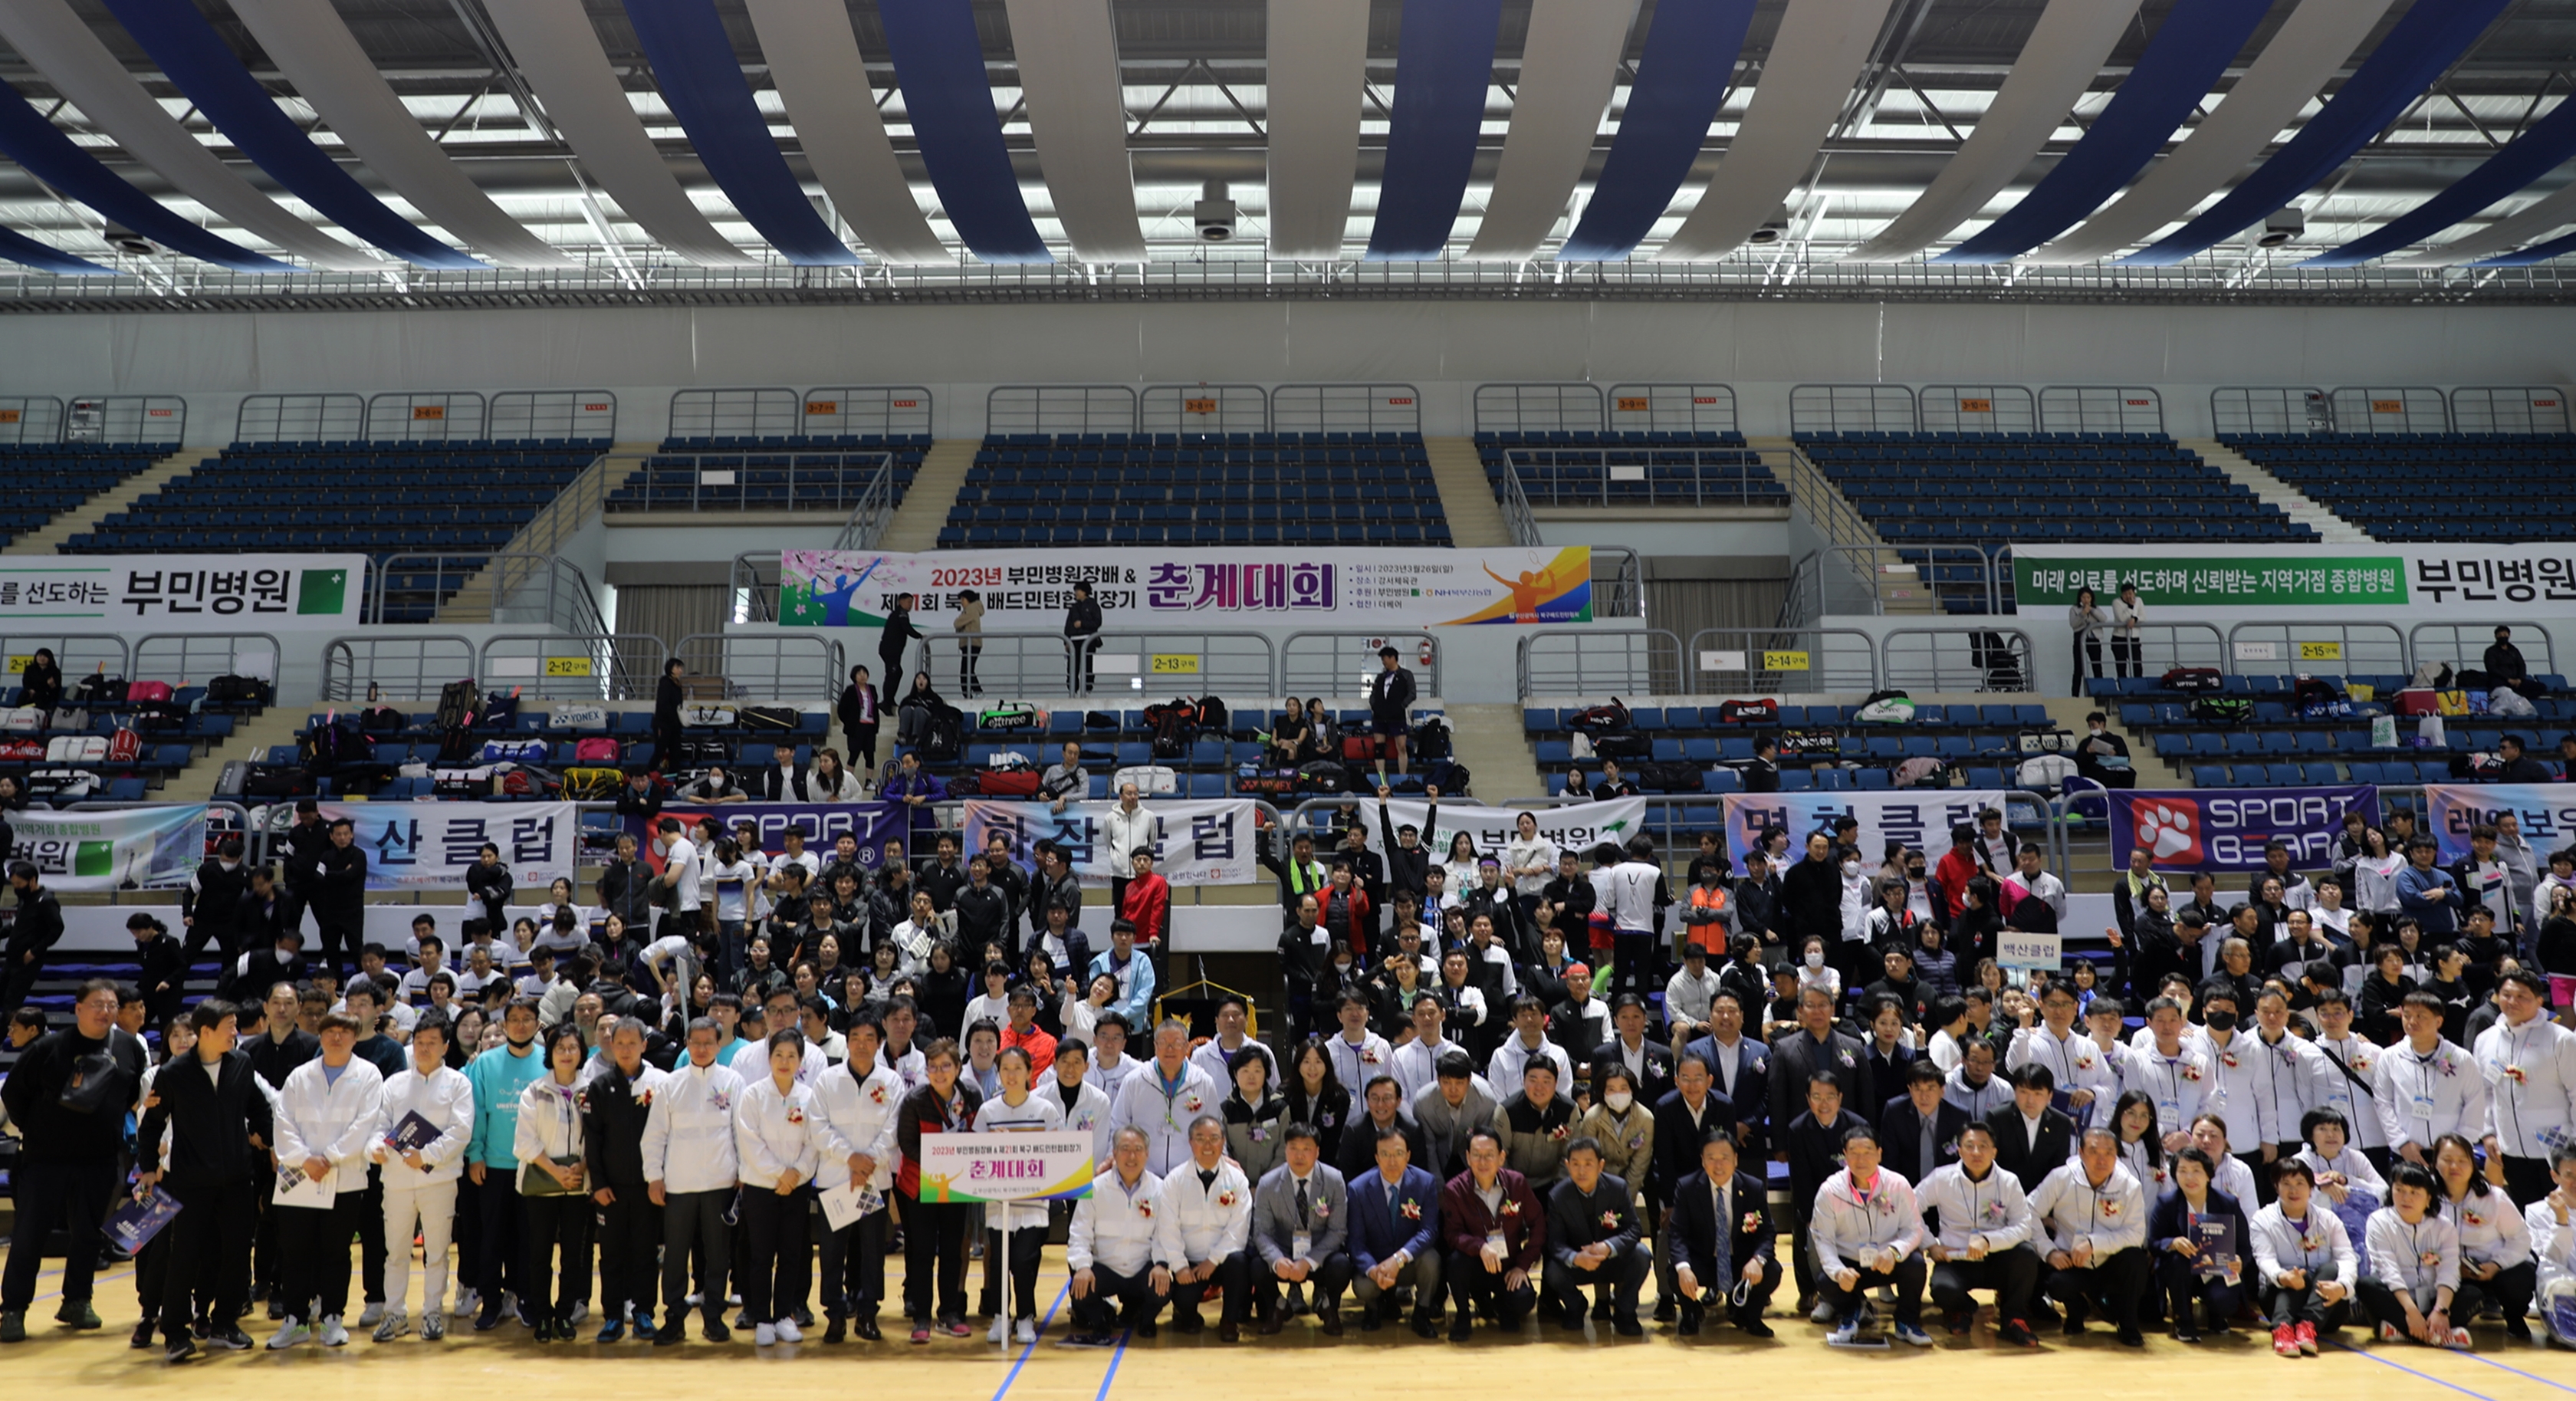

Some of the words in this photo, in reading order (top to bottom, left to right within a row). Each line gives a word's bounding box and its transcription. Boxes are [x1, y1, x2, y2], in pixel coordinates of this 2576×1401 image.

[931, 567, 1002, 587] 2023년
[1007, 566, 1119, 585] 부민병원장배
[1125, 569, 1136, 584] &
[1147, 562, 1336, 610] 춘계대회
[2032, 569, 2064, 594] 미래
[2068, 569, 2118, 594] 의료를
[2192, 569, 2258, 594] 신뢰받는
[2262, 568, 2326, 594] 지역거점
[2330, 567, 2395, 594] 종합병원
[2417, 557, 2576, 603] 부민병원
[25, 581, 109, 605] 선도하는
[122, 570, 291, 615] 부민병원
[881, 592, 939, 612] 제1회
[945, 592, 980, 611] 북
[987, 590, 1136, 612] 배드민턴협장기
[1766, 655, 1792, 666] 2-14
[2302, 646, 2325, 656] 2-15
[548, 660, 572, 673] 2-12
[1155, 658, 1179, 669] 2-13
[570, 711, 600, 723] YONEX
[2210, 795, 2354, 828] SPORT
[15, 823, 55, 836] 지역거점
[727, 810, 882, 844] SPORT
[2003, 943, 2055, 958] 백산클럽
[932, 1146, 955, 1156] 2023년
[998, 1144, 1018, 1155] 제21회
[969, 1158, 1045, 1179] 춘계대회
